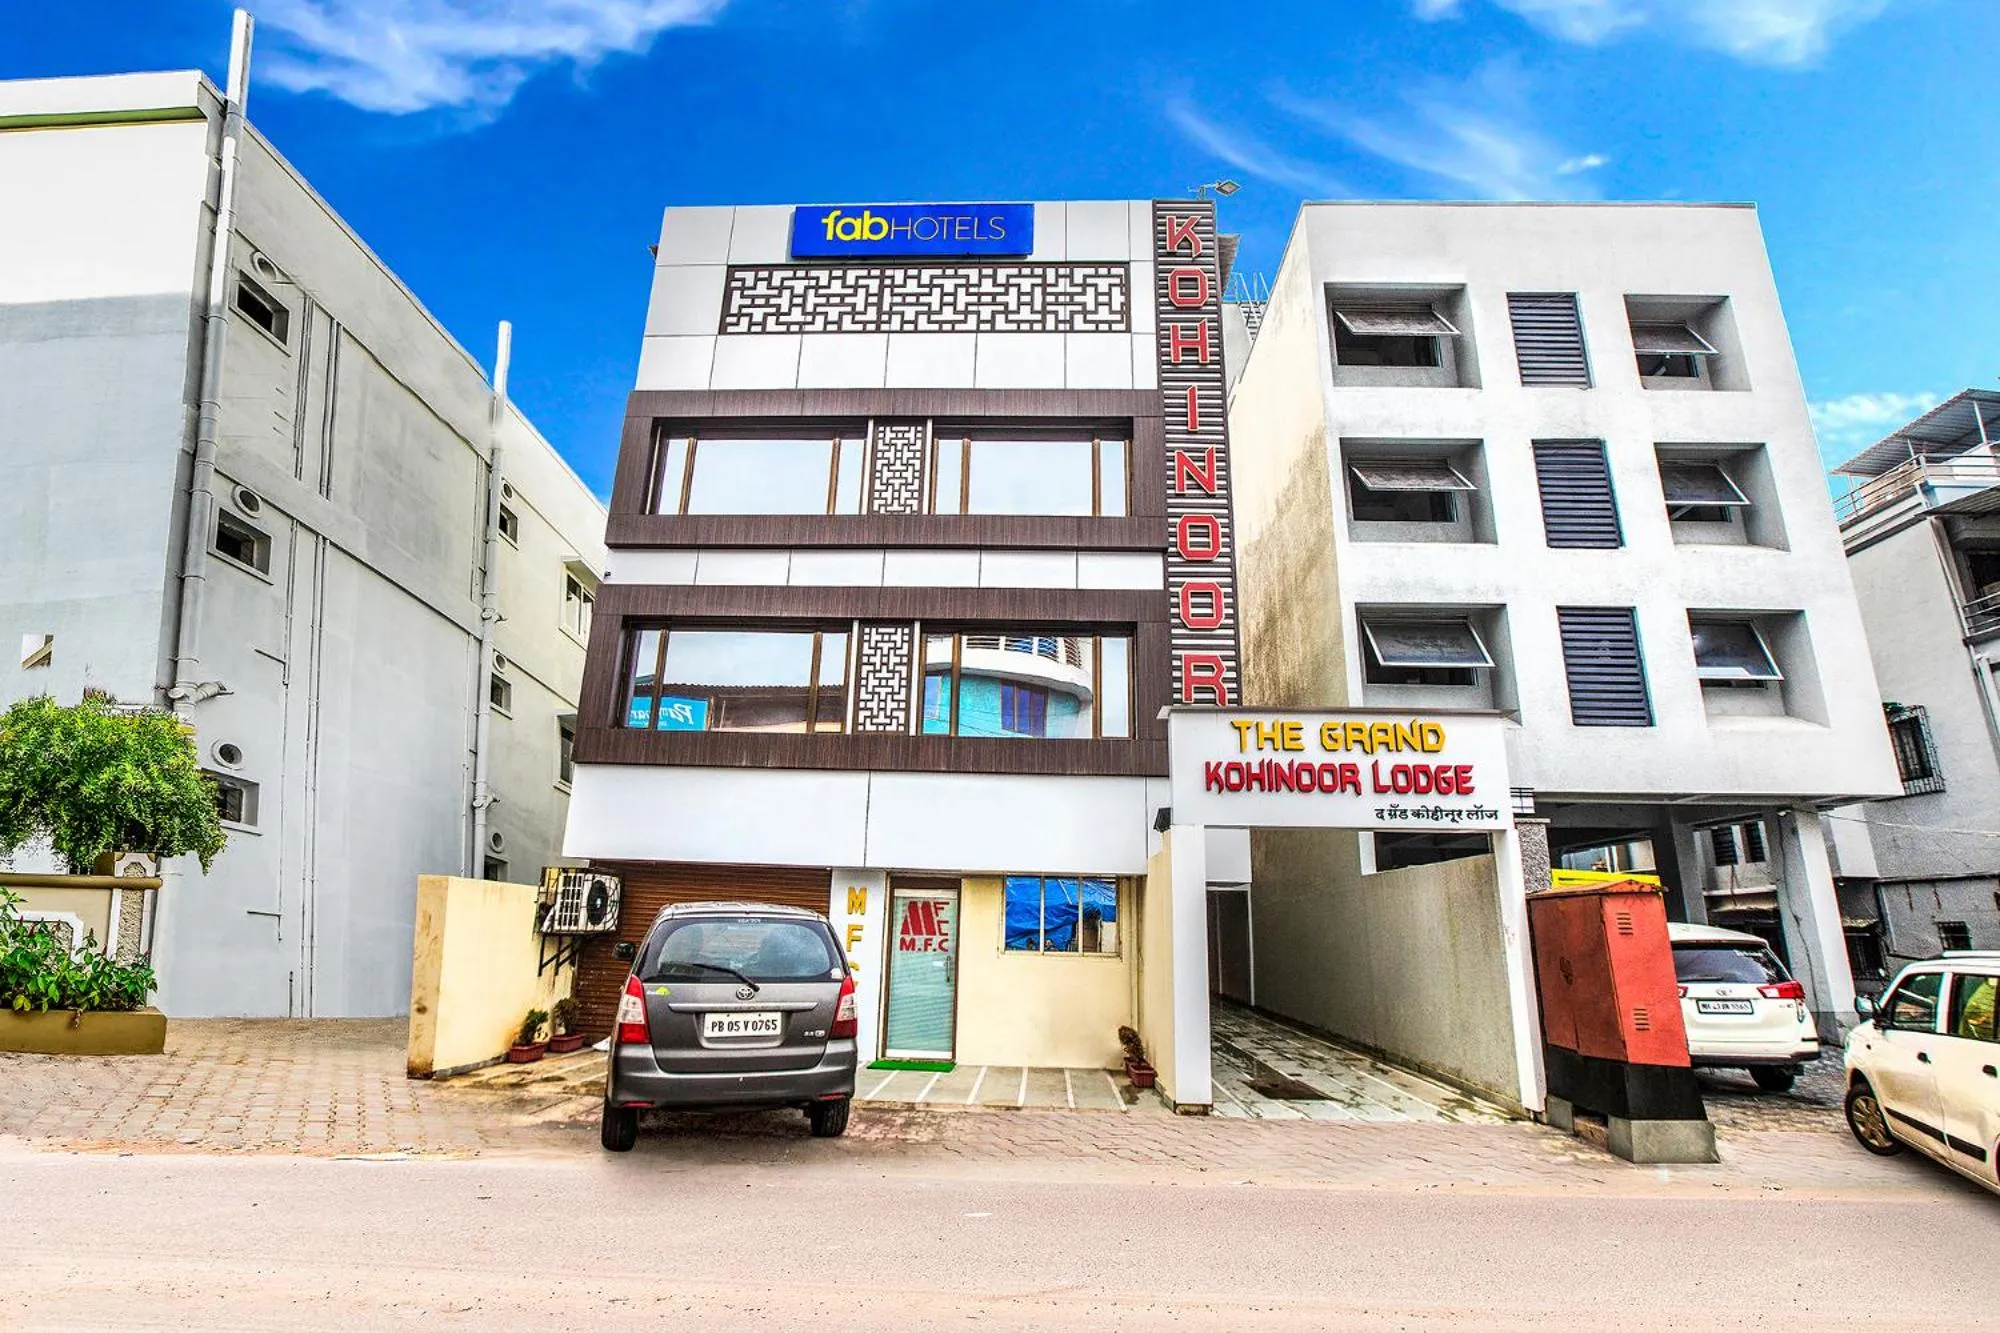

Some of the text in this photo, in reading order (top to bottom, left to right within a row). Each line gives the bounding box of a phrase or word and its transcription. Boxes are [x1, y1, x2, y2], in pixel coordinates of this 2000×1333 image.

[1166, 215, 1228, 707] KOHINOOR
[1231, 718, 1446, 754] THE GRAND
[1204, 757, 1475, 796] KOHINOOR LODGE
[1375, 808, 1385, 820] द
[1465, 804, 1498, 820] लॉज
[711, 1019, 778, 1032] PB 05 V 0765
